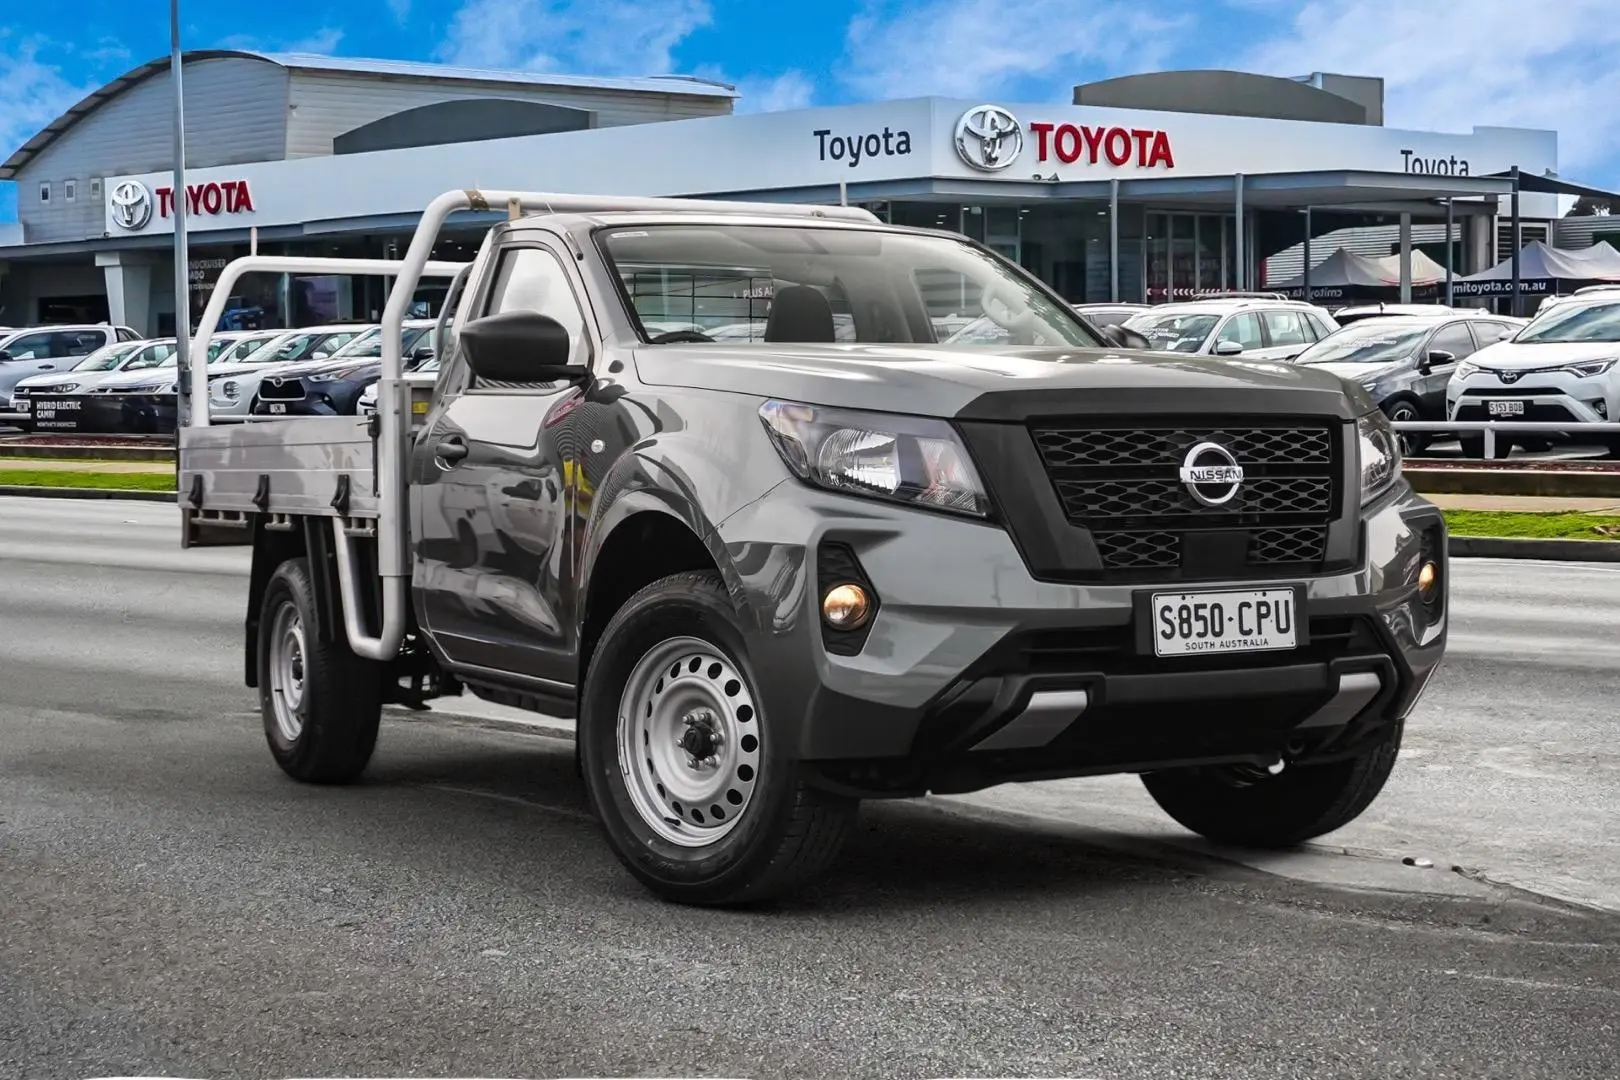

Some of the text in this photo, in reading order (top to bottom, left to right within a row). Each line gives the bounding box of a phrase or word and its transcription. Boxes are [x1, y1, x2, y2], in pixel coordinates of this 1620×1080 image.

[813, 127, 911, 168] Toyota
[1030, 122, 1174, 168] TOYOTA
[1400, 149, 1469, 176] Toyota
[743, 287, 763, 299] PLUS
[1453, 282, 1547, 295] mitoyota.cm.au
[57, 401, 81, 410] ELECTRIC
[1190, 469, 1240, 480] NISSAN
[1185, 638, 1269, 651] SOUTH AUSTRALIA
